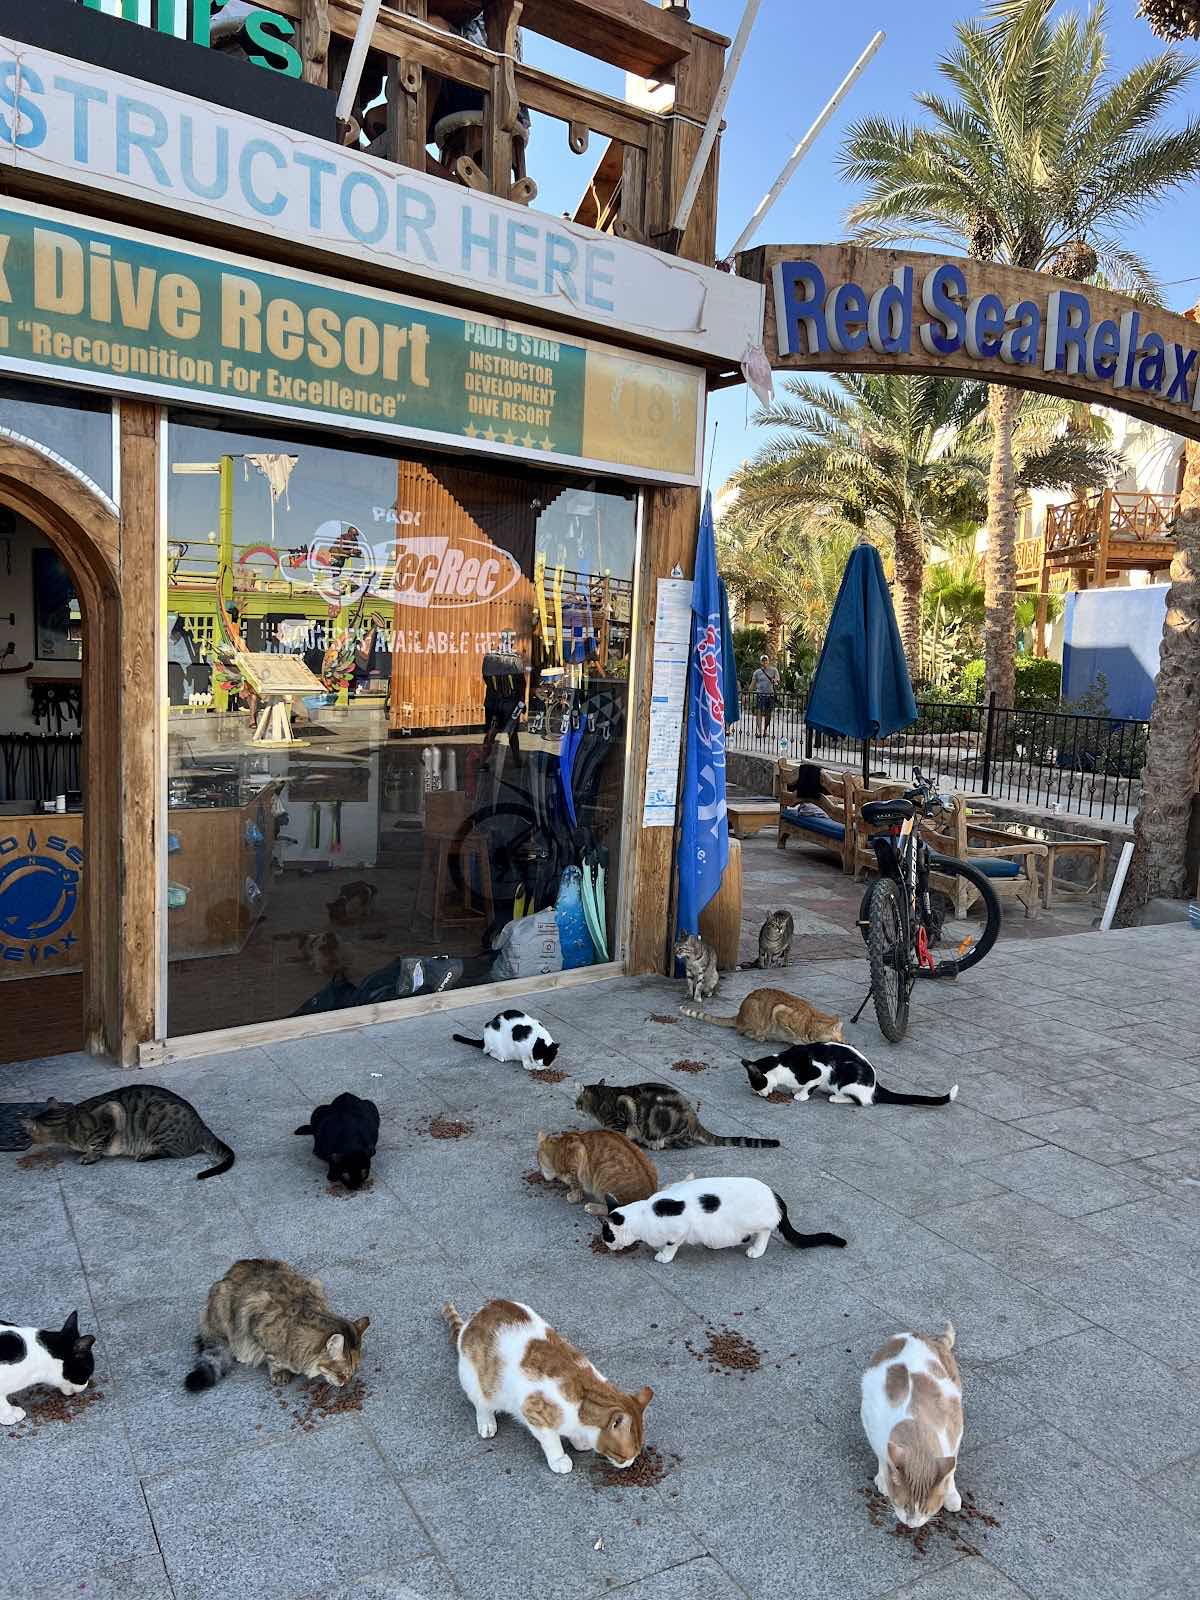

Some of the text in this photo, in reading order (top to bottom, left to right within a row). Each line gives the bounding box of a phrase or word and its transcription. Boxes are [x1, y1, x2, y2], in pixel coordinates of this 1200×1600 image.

[0, 61, 616, 313] STRUCTOR HERE
[34, 227, 201, 340] Dive
[221, 272, 431, 388] Resort
[464, 320, 560, 363] PADI 5 STAR
[772, 260, 1198, 404] Red Sea Relax
[220, 357, 261, 394] For
[469, 350, 553, 387] INSTRUCTOR
[464, 372, 558, 408] DEVELOPMENT
[468, 394, 552, 428] DIVE RESORT
[372, 506, 421, 527] PADI
[374, 630, 469, 656] AVAILABLE
[474, 630, 517, 655] HERE
